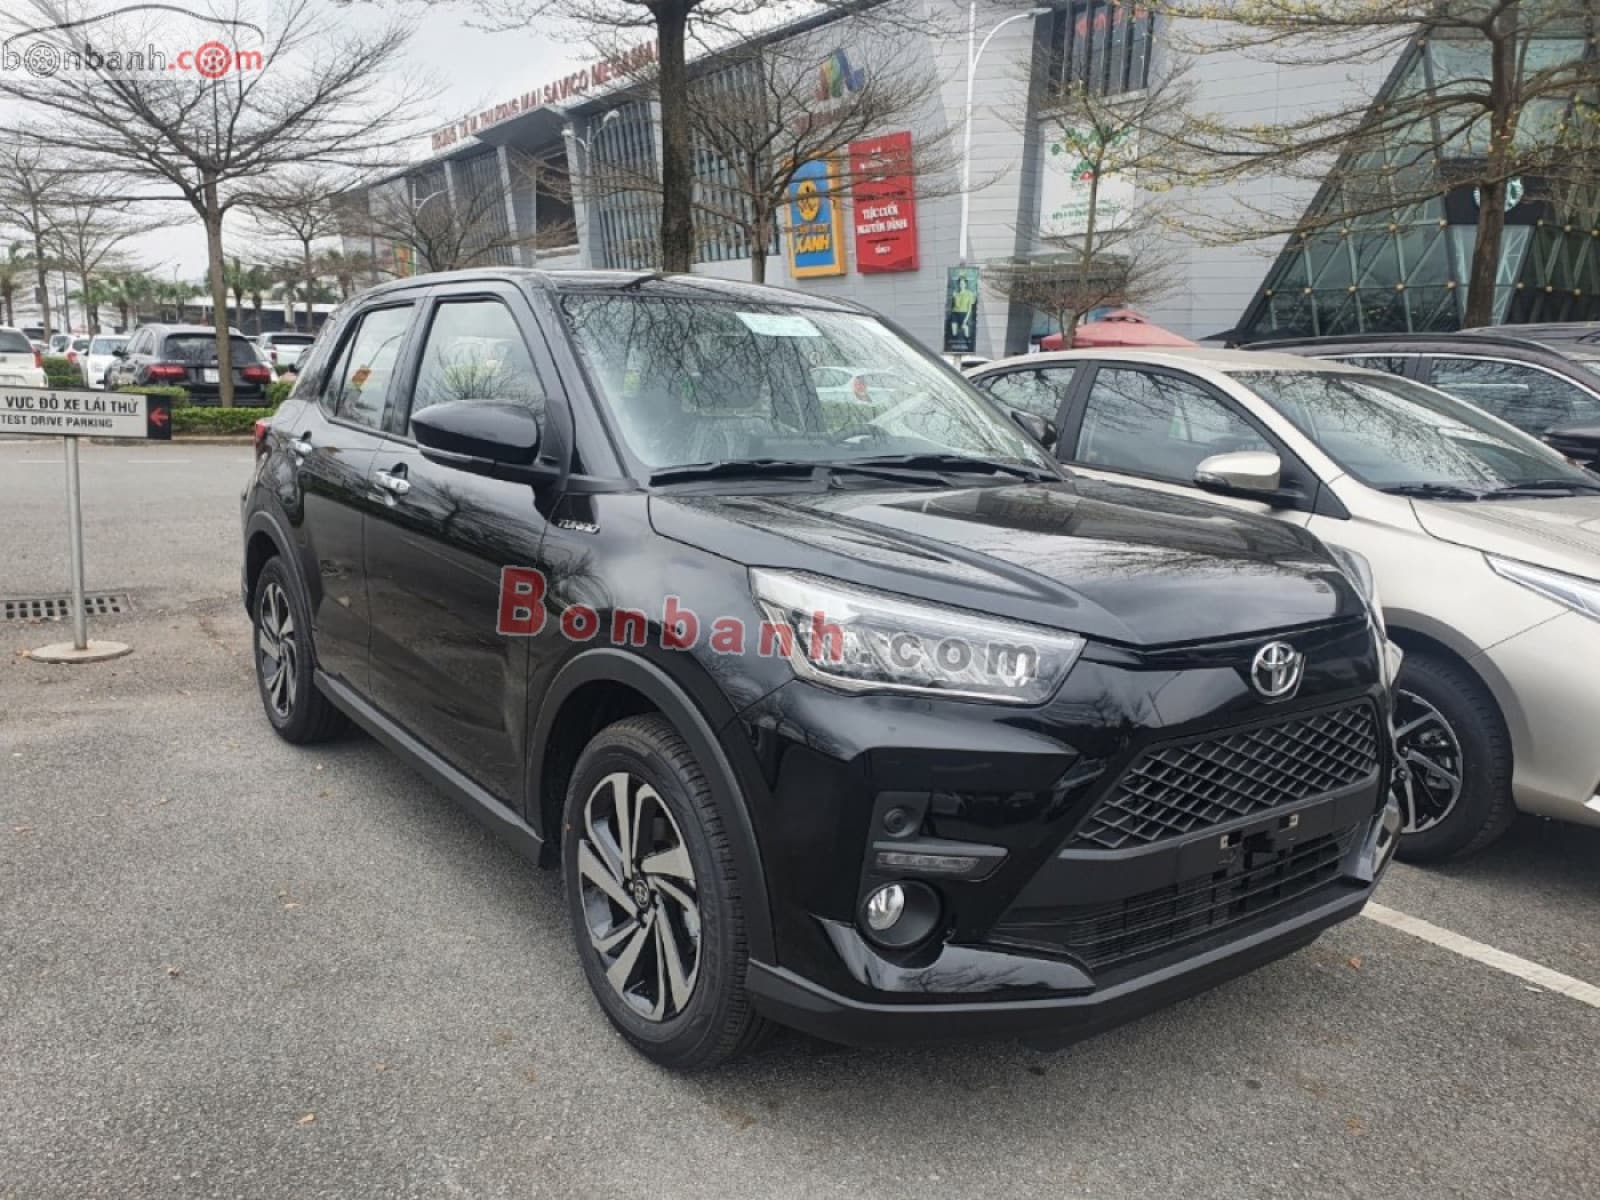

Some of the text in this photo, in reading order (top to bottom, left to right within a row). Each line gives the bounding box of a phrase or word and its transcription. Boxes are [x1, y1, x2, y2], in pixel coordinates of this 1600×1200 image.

[543, 69, 589, 105] SAVICO
[63, 398, 81, 410] XE
[84, 396, 105, 412] LÁI
[1, 414, 113, 428] TEST DRIVE PARKING
